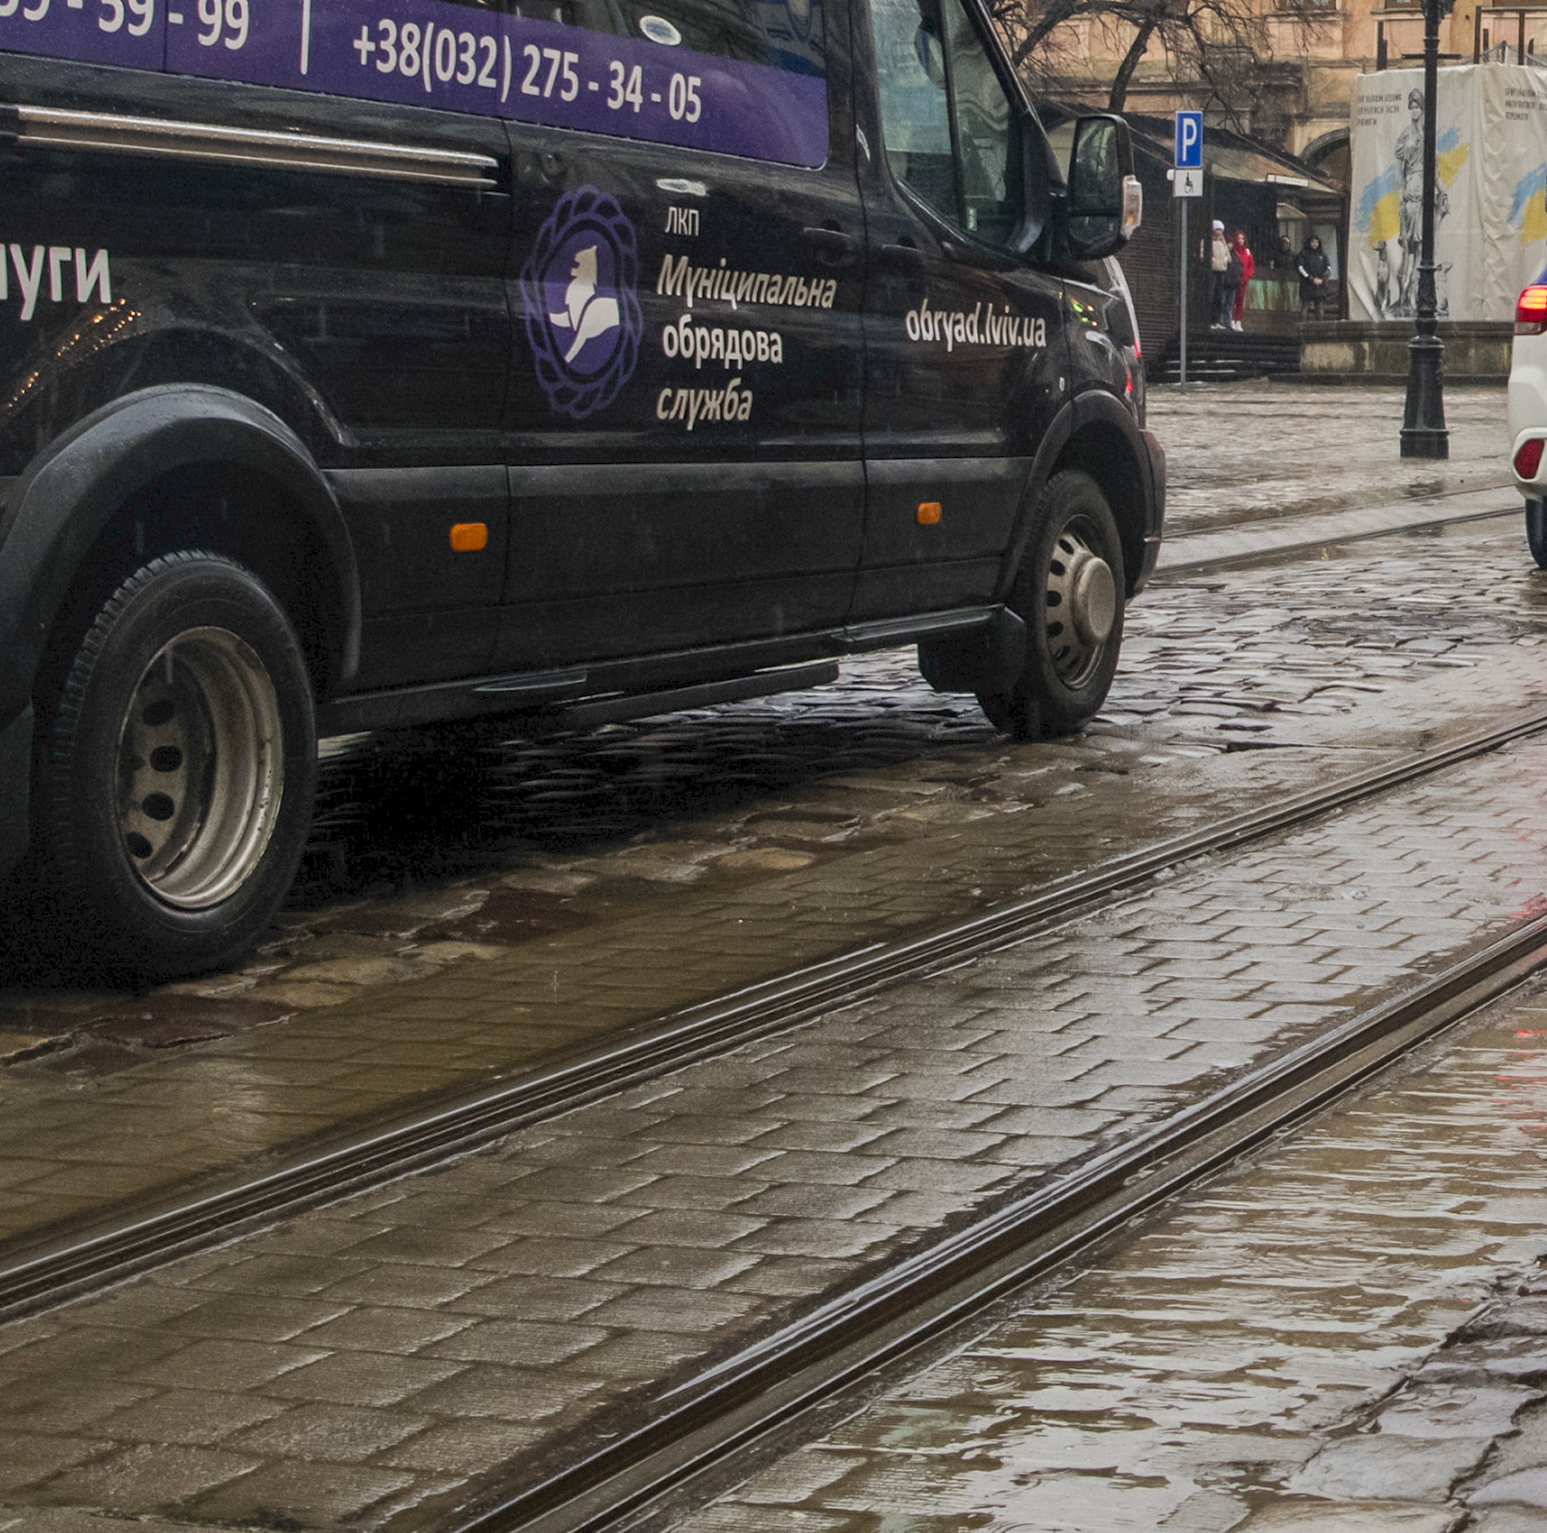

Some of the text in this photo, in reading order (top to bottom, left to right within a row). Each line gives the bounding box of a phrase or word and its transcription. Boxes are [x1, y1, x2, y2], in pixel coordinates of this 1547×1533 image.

[353, 18, 512, 103] +38(032)
[521, 44, 579, 102] 275
[607, 61, 643, 113] 34
[669, 72, 702, 123] 05
[1182, 117, 1198, 162] P
[665, 206, 699, 236] ЛКП
[657, 254, 837, 310] Муніципальна
[662, 314, 783, 369] обрядова
[906, 298, 1046, 352] obryad.lviv.ua
[656, 377, 753, 431] служба
